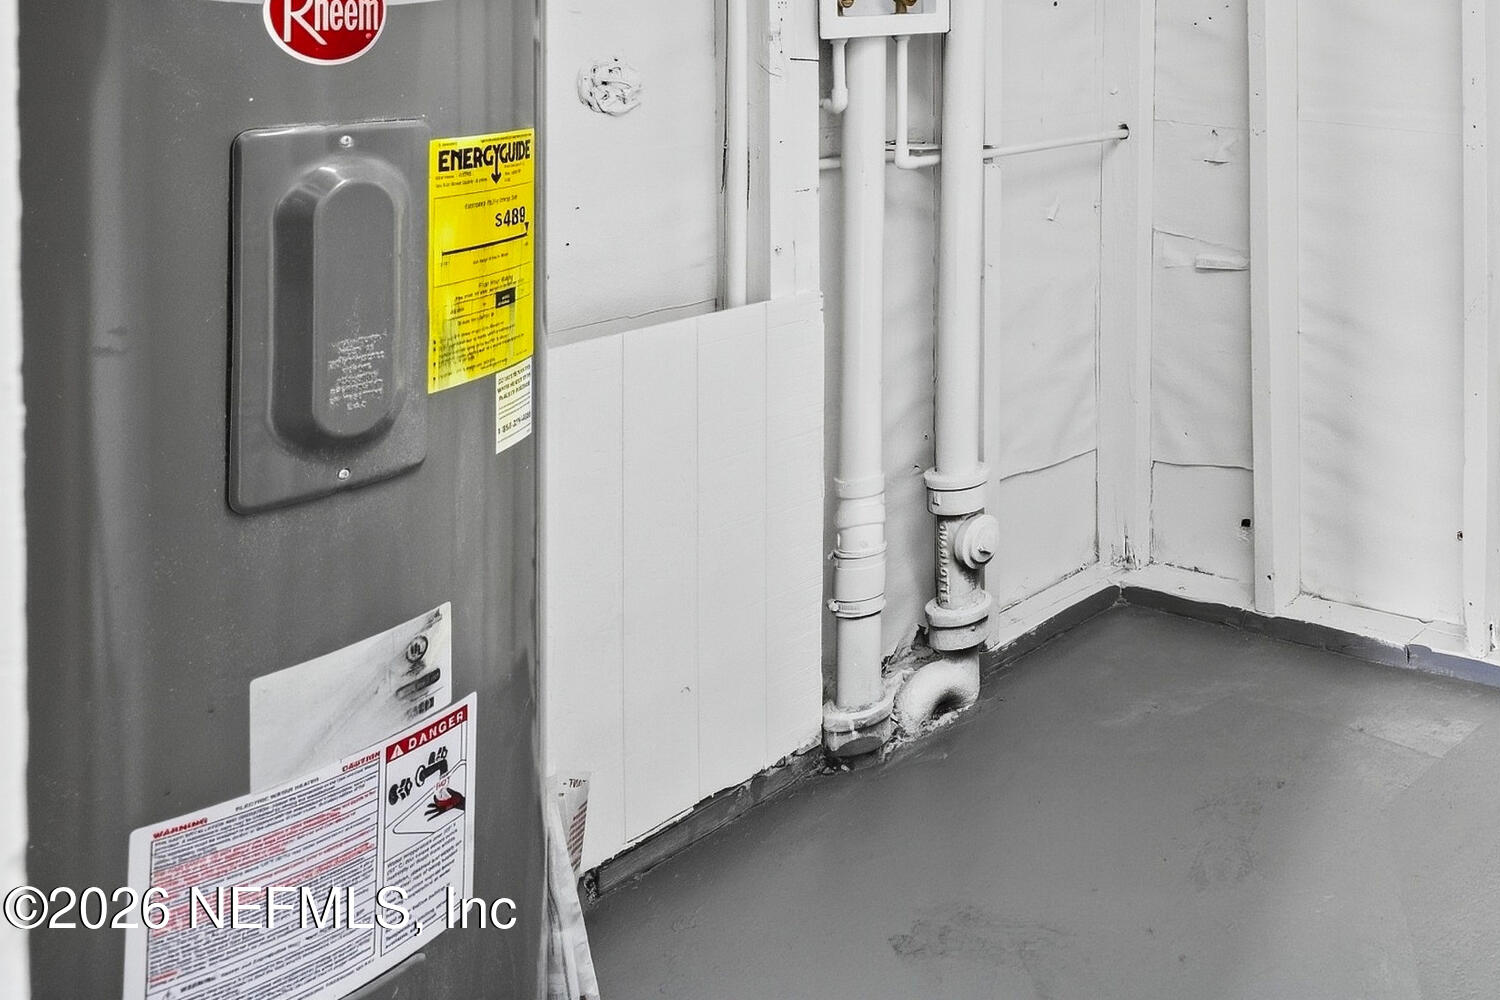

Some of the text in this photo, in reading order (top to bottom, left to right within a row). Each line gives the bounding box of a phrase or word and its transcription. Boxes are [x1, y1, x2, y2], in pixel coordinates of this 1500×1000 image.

[438, 139, 531, 184] ENERGYGUIDE
[494, 206, 526, 228] $489
[408, 710, 464, 749] DANGER
[153, 816, 208, 840] WARNING
